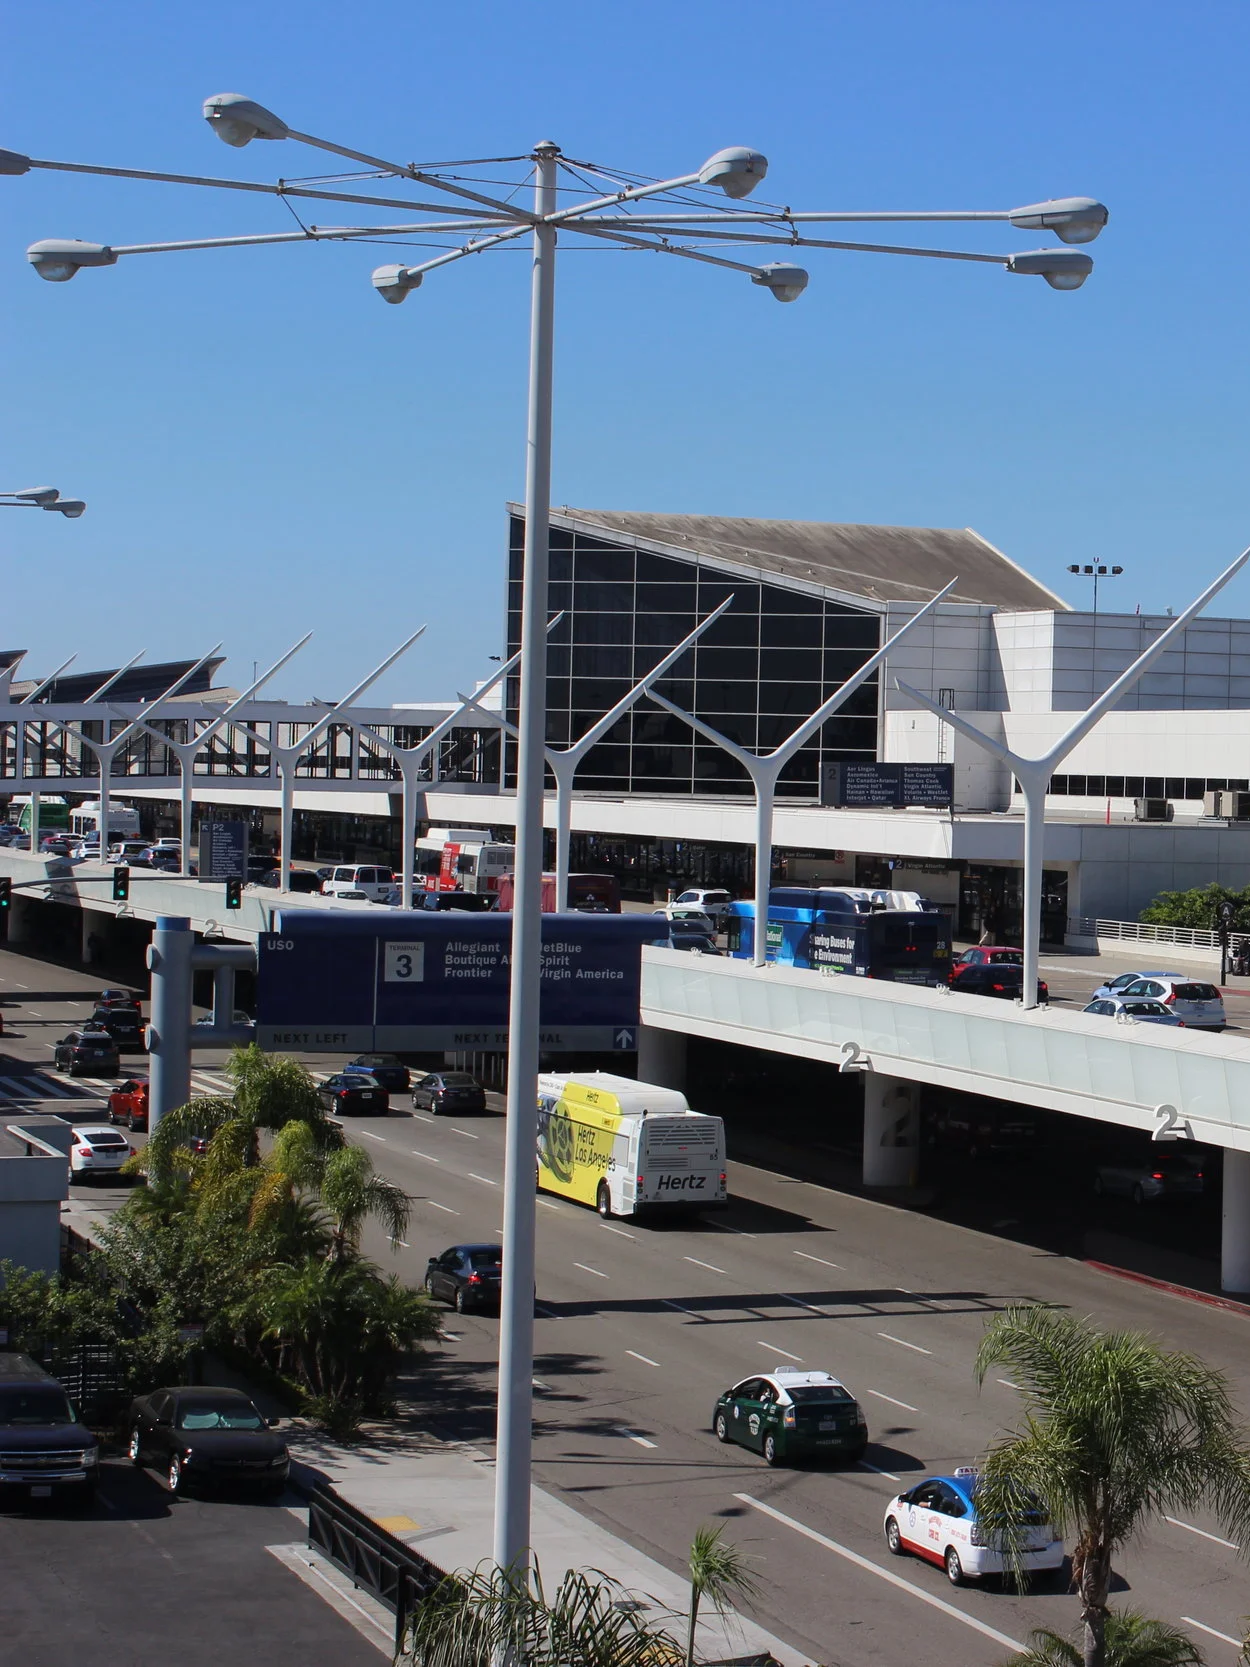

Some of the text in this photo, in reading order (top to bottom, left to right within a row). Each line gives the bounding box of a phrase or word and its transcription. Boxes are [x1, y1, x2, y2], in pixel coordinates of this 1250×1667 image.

[828, 769, 836, 780] 2
[212, 823, 225, 831] P2
[896, 859, 902, 869] 2
[115, 901, 128, 918] 2
[1222, 906, 1230, 916] A
[203, 918, 217, 938] 2
[267, 940, 294, 950] USO
[445, 942, 500, 953] Allegiant
[830, 935, 846, 949] Buses
[846, 936, 855, 949] for
[445, 955, 497, 967] Boutique
[539, 955, 570, 967] Spirit
[818, 948, 852, 964] Environment
[396, 954, 412, 978] 3
[444, 968, 493, 978] Frontier
[575, 968, 624, 979] America
[273, 1033, 348, 1044] NEXT LEFT
[454, 1033, 488, 1044] NEXT
[839, 1040, 861, 1073] 2
[586, 1090, 599, 1104] Hertz
[880, 1086, 914, 1148] 2
[1152, 1104, 1177, 1141] 2
[577, 1125, 596, 1146] Hertz
[575, 1143, 616, 1172] Los Angeles
[657, 1174, 706, 1190] Hertz
